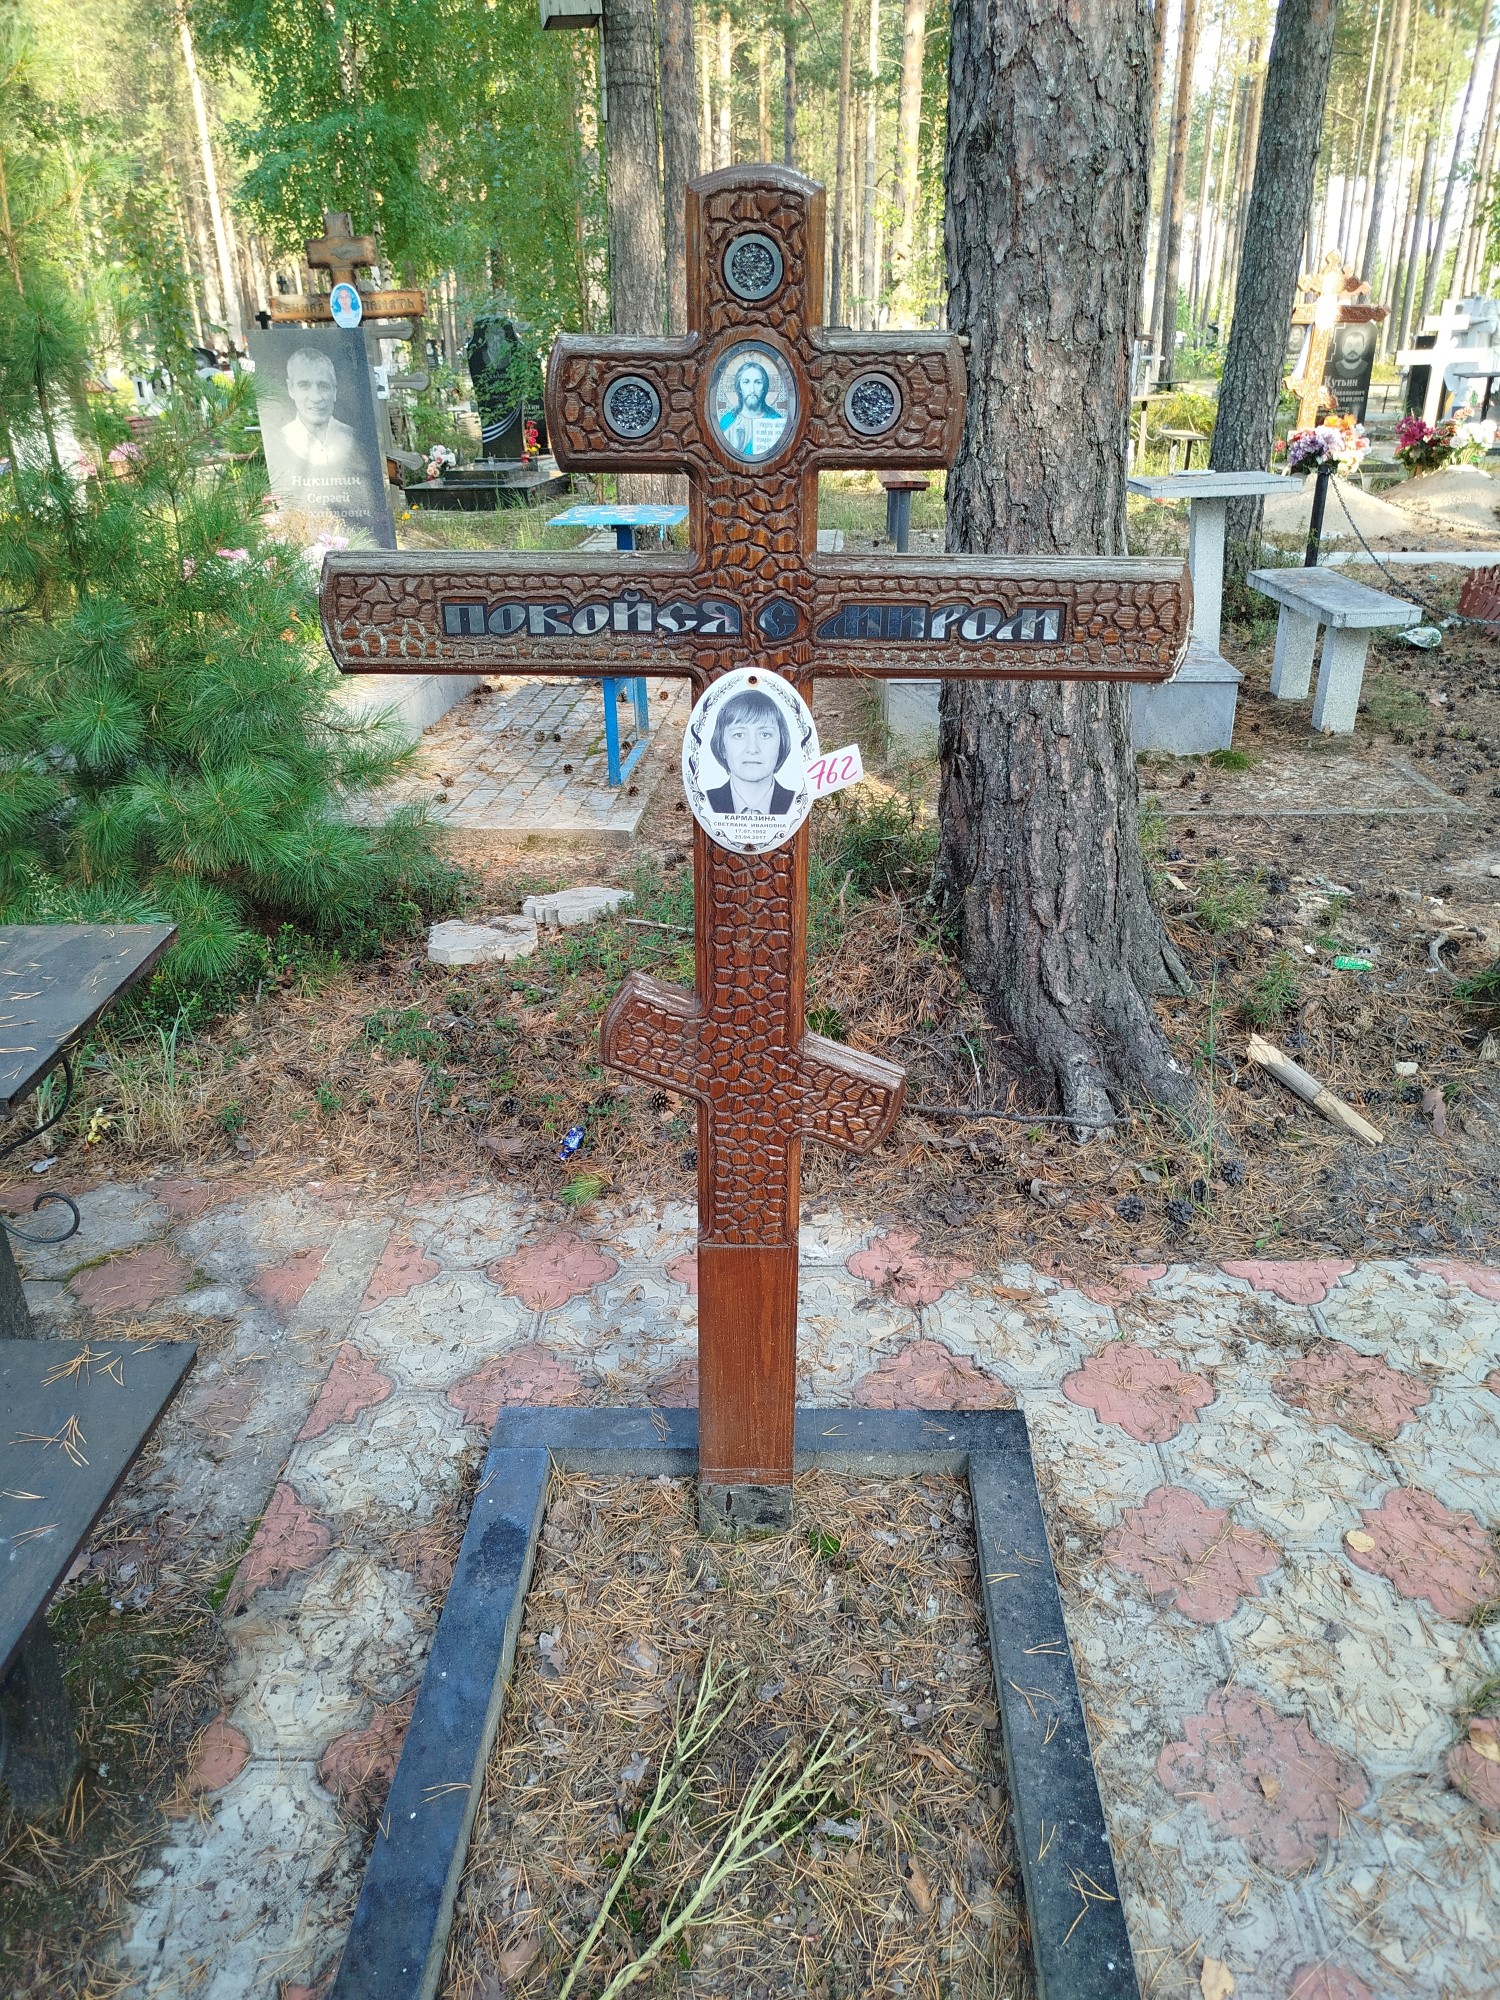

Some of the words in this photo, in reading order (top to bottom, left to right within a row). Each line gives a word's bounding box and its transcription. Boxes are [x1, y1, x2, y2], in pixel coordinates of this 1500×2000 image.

[291, 475, 361, 487] Никитин
[307, 491, 351, 505] Сергей
[806, 755, 858, 790] 762
[724, 814, 777, 822] КАРМАЗИНА
